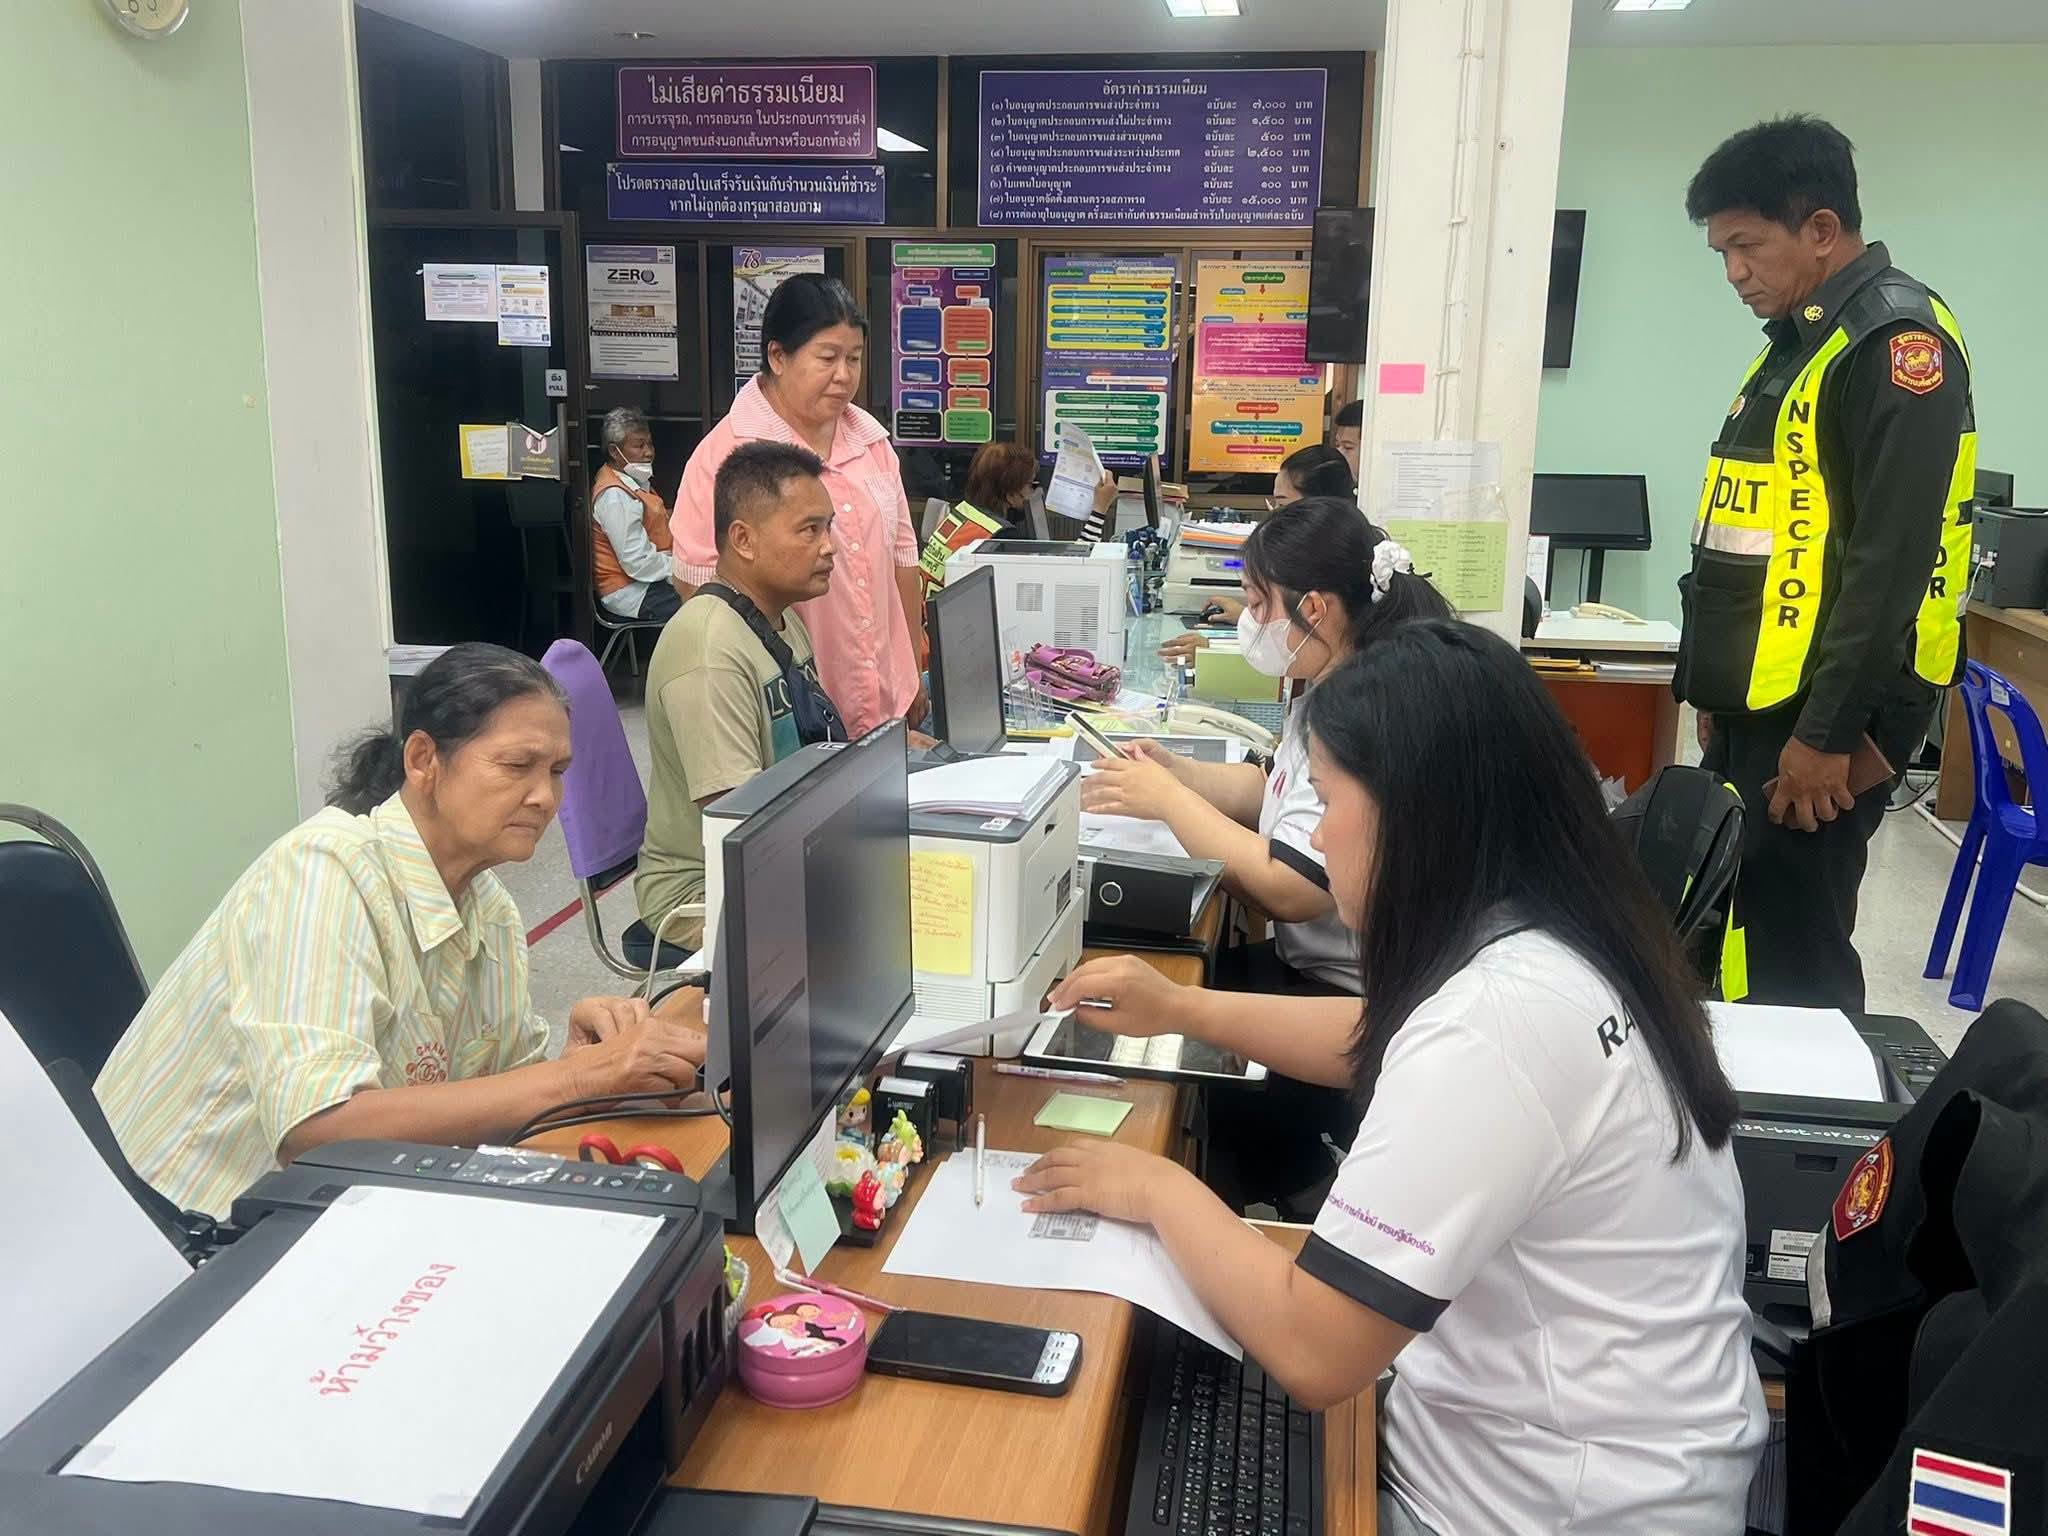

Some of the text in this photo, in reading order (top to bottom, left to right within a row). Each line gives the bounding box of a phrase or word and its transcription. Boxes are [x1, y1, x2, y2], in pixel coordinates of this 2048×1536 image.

[648, 74, 844, 105] ไม่เสียค่าธรรมเนียม
[1103, 79, 1208, 97] อัตราค่าธรรมเนียม
[1207, 98, 1237, 109] ฉบับละ
[696, 113, 753, 125] การถอนรถ
[757, 109, 866, 126] ในประกอบการขนส่ง
[1206, 113, 1237, 125] ฉบับละ
[1295, 117, 1312, 125] บาท
[631, 130, 861, 150] การอนุญาตขนส่งนอกเส้นทางหรือนอกท้องที่
[1206, 130, 1235, 141] ฉบับละ
[1205, 146, 1235, 157] ฉบับละ
[1204, 162, 1234, 173] ฉบับละ
[1292, 165, 1309, 173] บาท
[615, 170, 878, 193] โปรดตรวจสอบใบเสร็จรับเงินกับจำนวนเงินที่ชำระ
[1204, 177, 1233, 188] ฉบับละ
[670, 193, 822, 218] หากไม่ถูกต้องกรุณาสอบถาม
[1203, 193, 1233, 204] ฉบับละ
[740, 249, 761, 268] 78
[551, 373, 562, 382] ดึง
[548, 384, 565, 392] PULL
[1713, 475, 1769, 515] DLT
[1777, 370, 1811, 628] INSPECTOR
